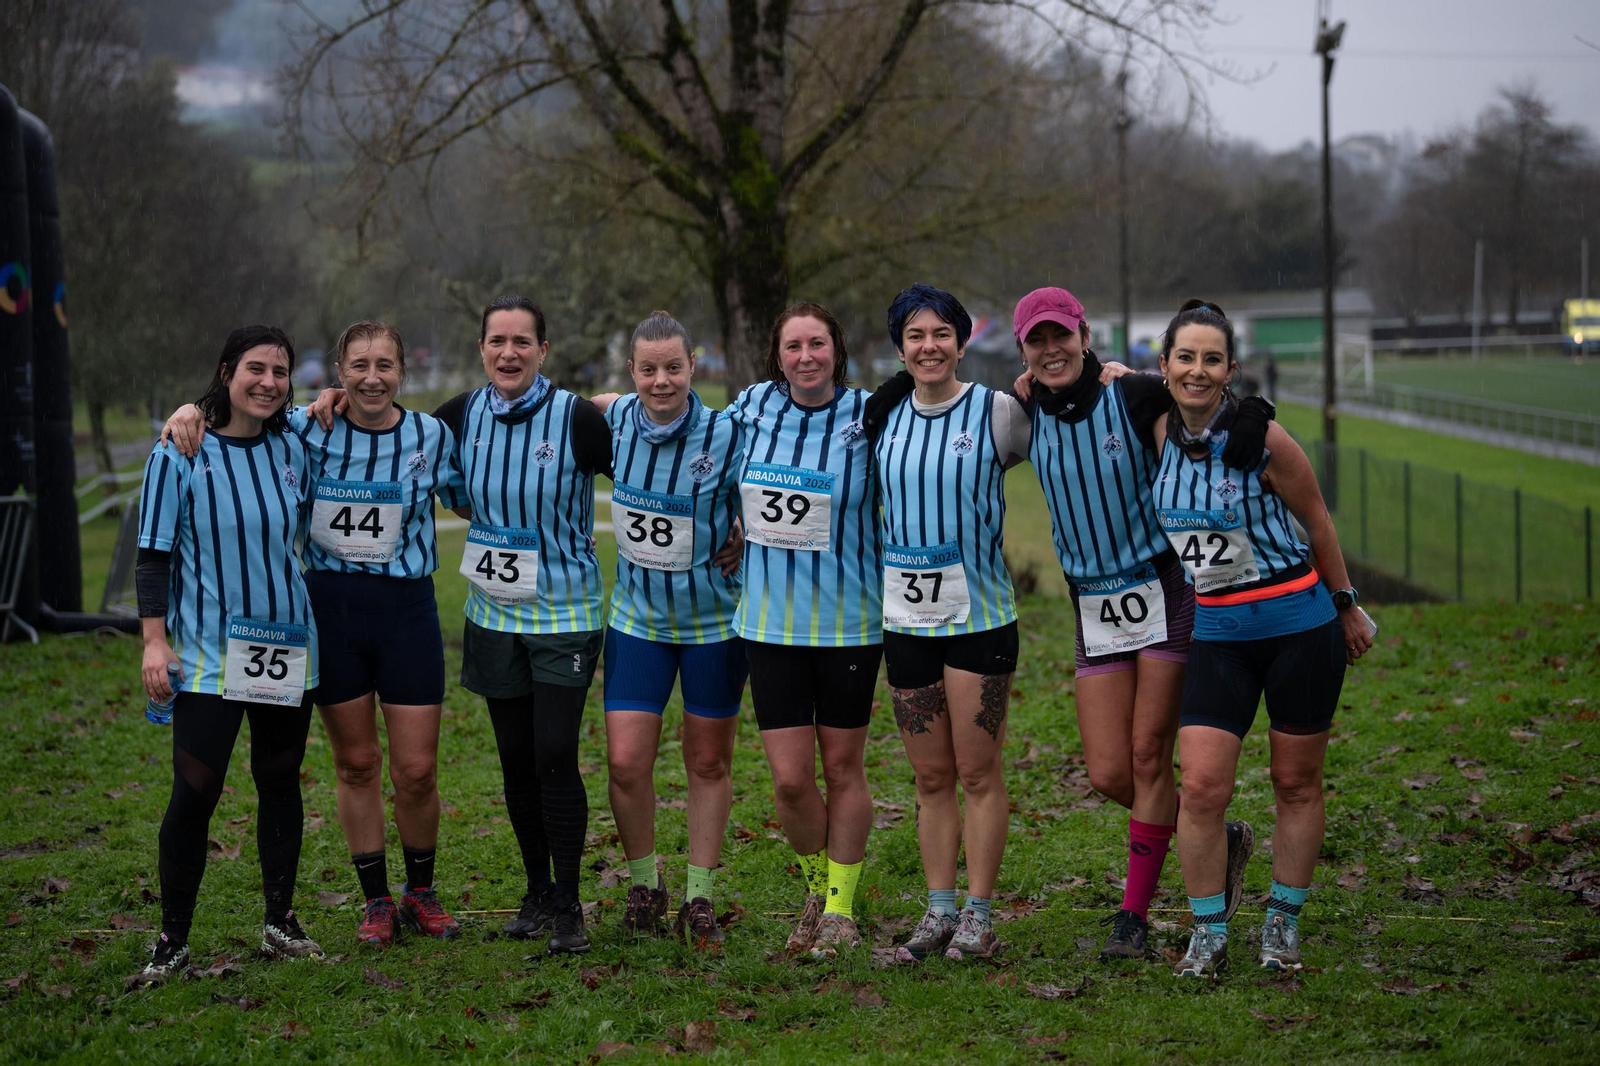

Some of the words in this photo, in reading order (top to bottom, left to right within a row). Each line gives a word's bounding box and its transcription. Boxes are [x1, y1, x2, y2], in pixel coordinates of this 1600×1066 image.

[746, 470, 802, 487] RIBADAVIA
[804, 477, 831, 491] 2026
[788, 466, 807, 474] CAMPO
[317, 485, 373, 500] RIBADAVIA
[375, 490, 401, 500] 2026
[613, 487, 664, 511] RIBADAVIA
[665, 502, 692, 514] 2026
[649, 491, 667, 499] CAMPO
[760, 489, 811, 526] 39
[329, 506, 384, 538] 44
[626, 510, 674, 548] 38
[468, 528, 509, 545] RIBADAVIA
[511, 536, 537, 546] 2026
[1180, 532, 1234, 568] 42
[475, 549, 520, 583] 43
[885, 551, 931, 565] RIBADAVIA
[932, 549, 959, 565] 2026
[900, 571, 943, 604] 37
[1100, 591, 1149, 628] 40
[231, 624, 286, 641] RIBADAVIA
[287, 632, 306, 643] 2026
[243, 645, 290, 681] 35
[573, 654, 581, 672] FILA
